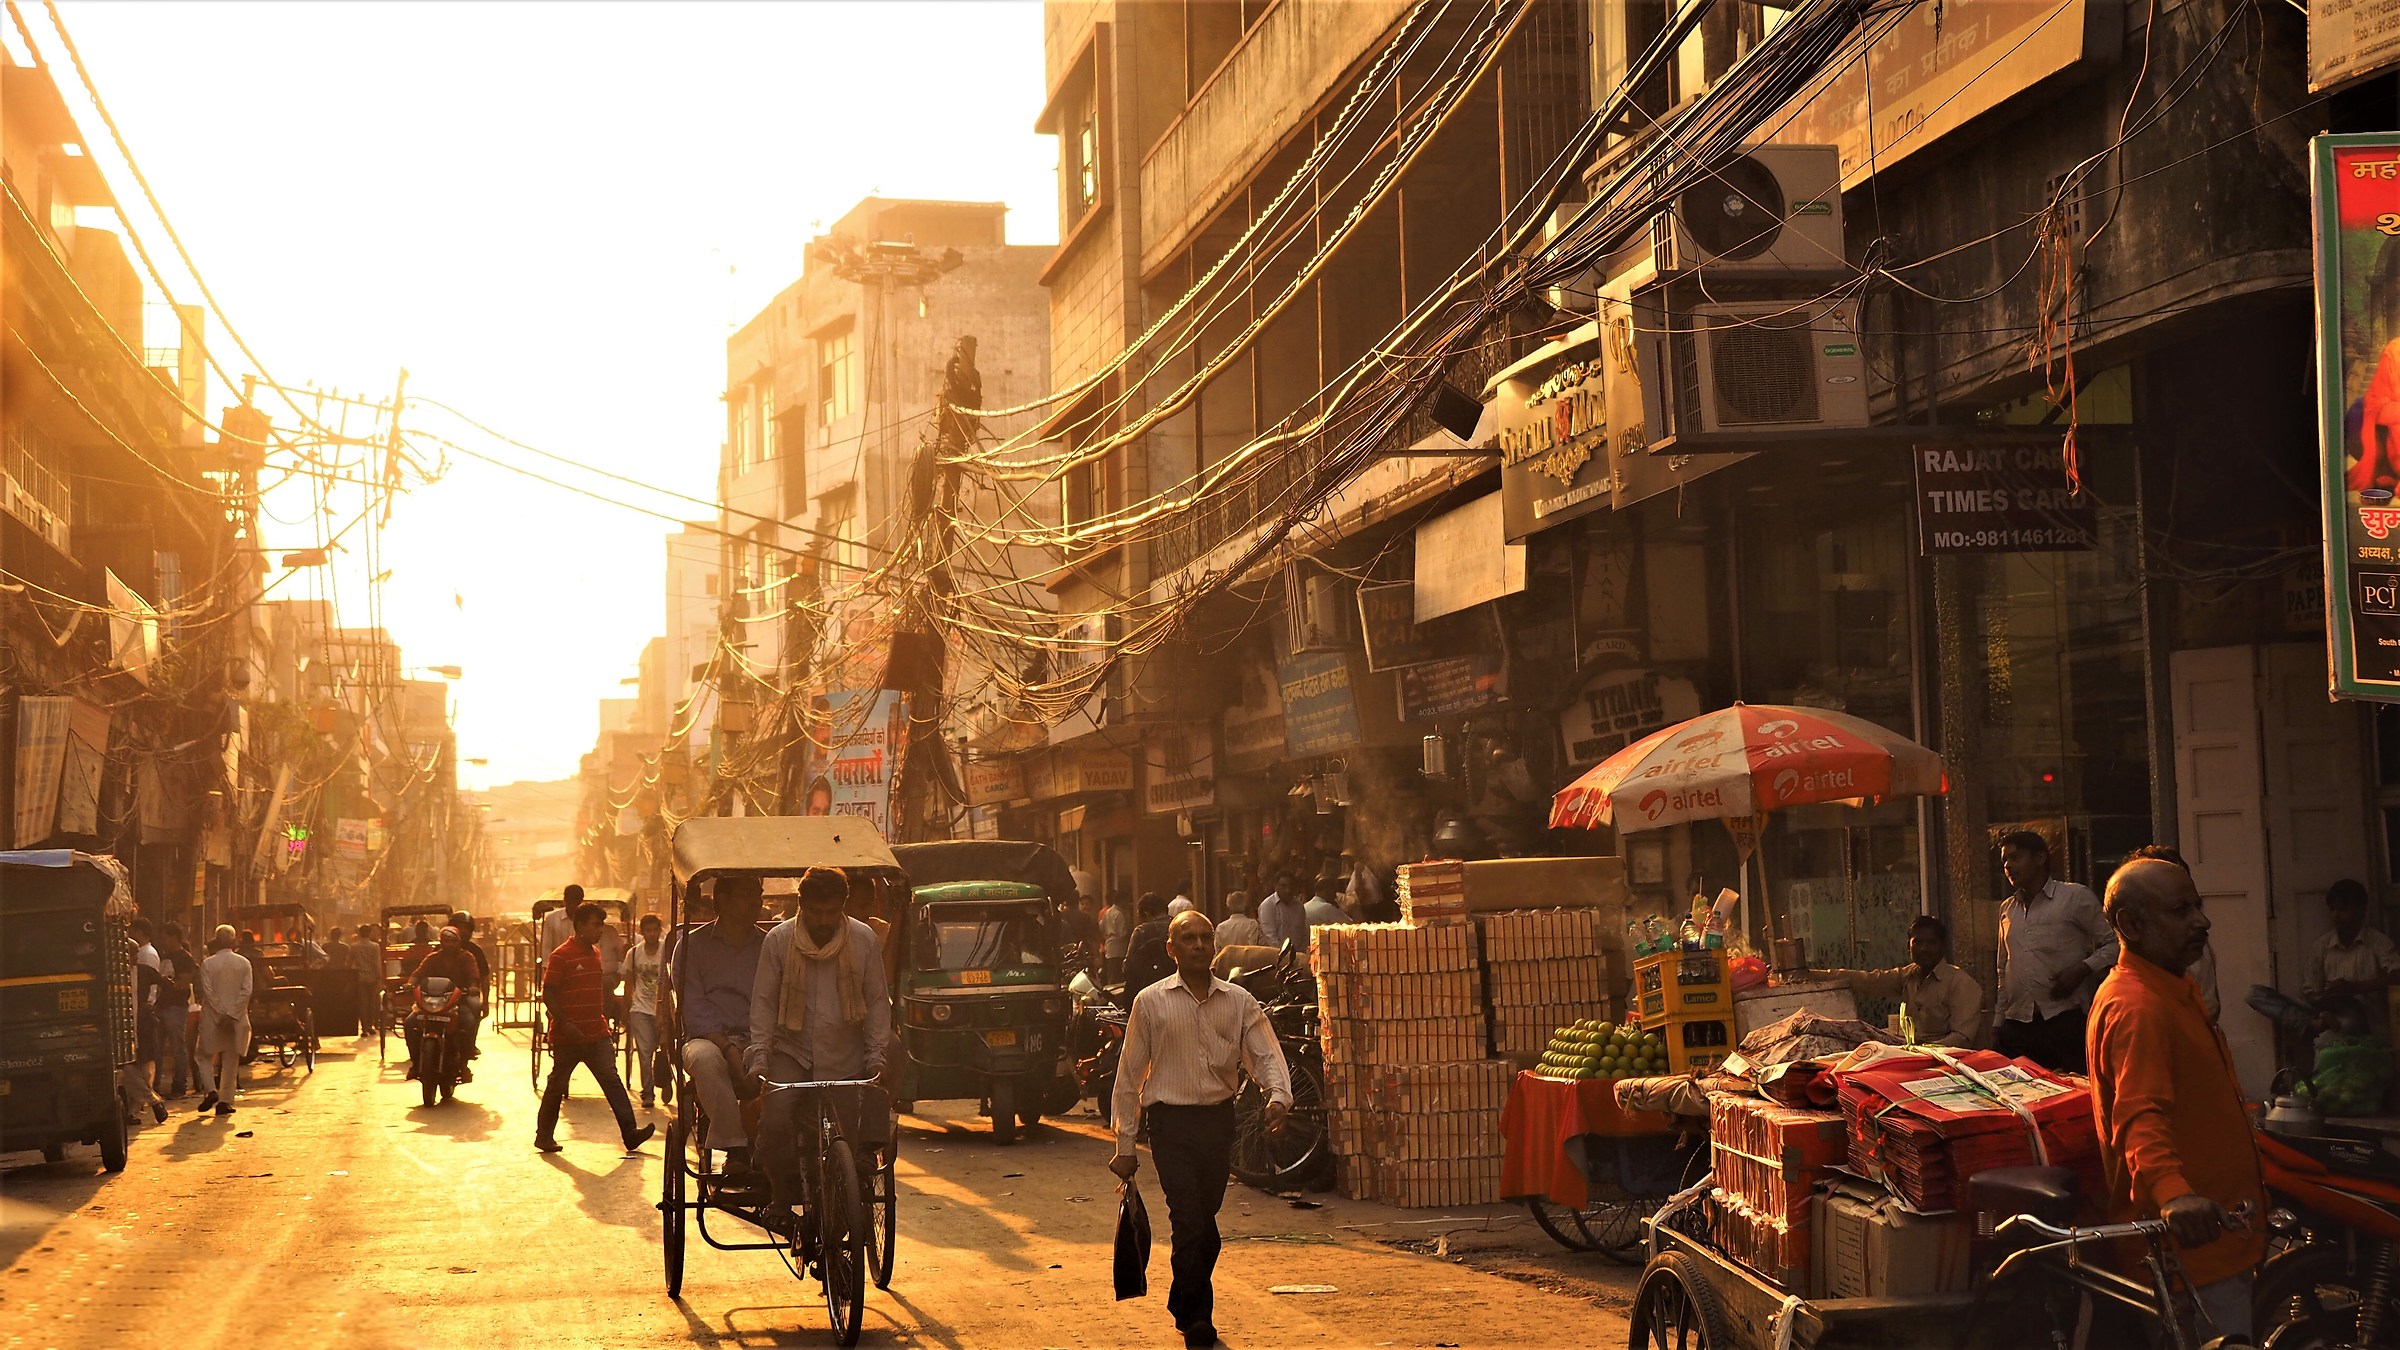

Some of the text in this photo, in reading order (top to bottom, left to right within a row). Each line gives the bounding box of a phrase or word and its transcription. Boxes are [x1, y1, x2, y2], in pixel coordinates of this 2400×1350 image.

[1885, 65, 1913, 95] का
[1500, 416, 1553, 469] SPECIAL
[1924, 449, 2006, 473] RAJAT
[1928, 487, 2087, 513] TIMES CARD
[2364, 586, 2397, 609] PCJ
[1596, 641, 1627, 651] CARD
[1586, 672, 1662, 720] TITANIC
[1765, 734, 1846, 759] airtel
[1084, 770, 1129, 787] YADAV
[1645, 754, 1725, 779] airtel
[1802, 768, 1854, 791] airtel
[1672, 791, 1724, 811] airtel
